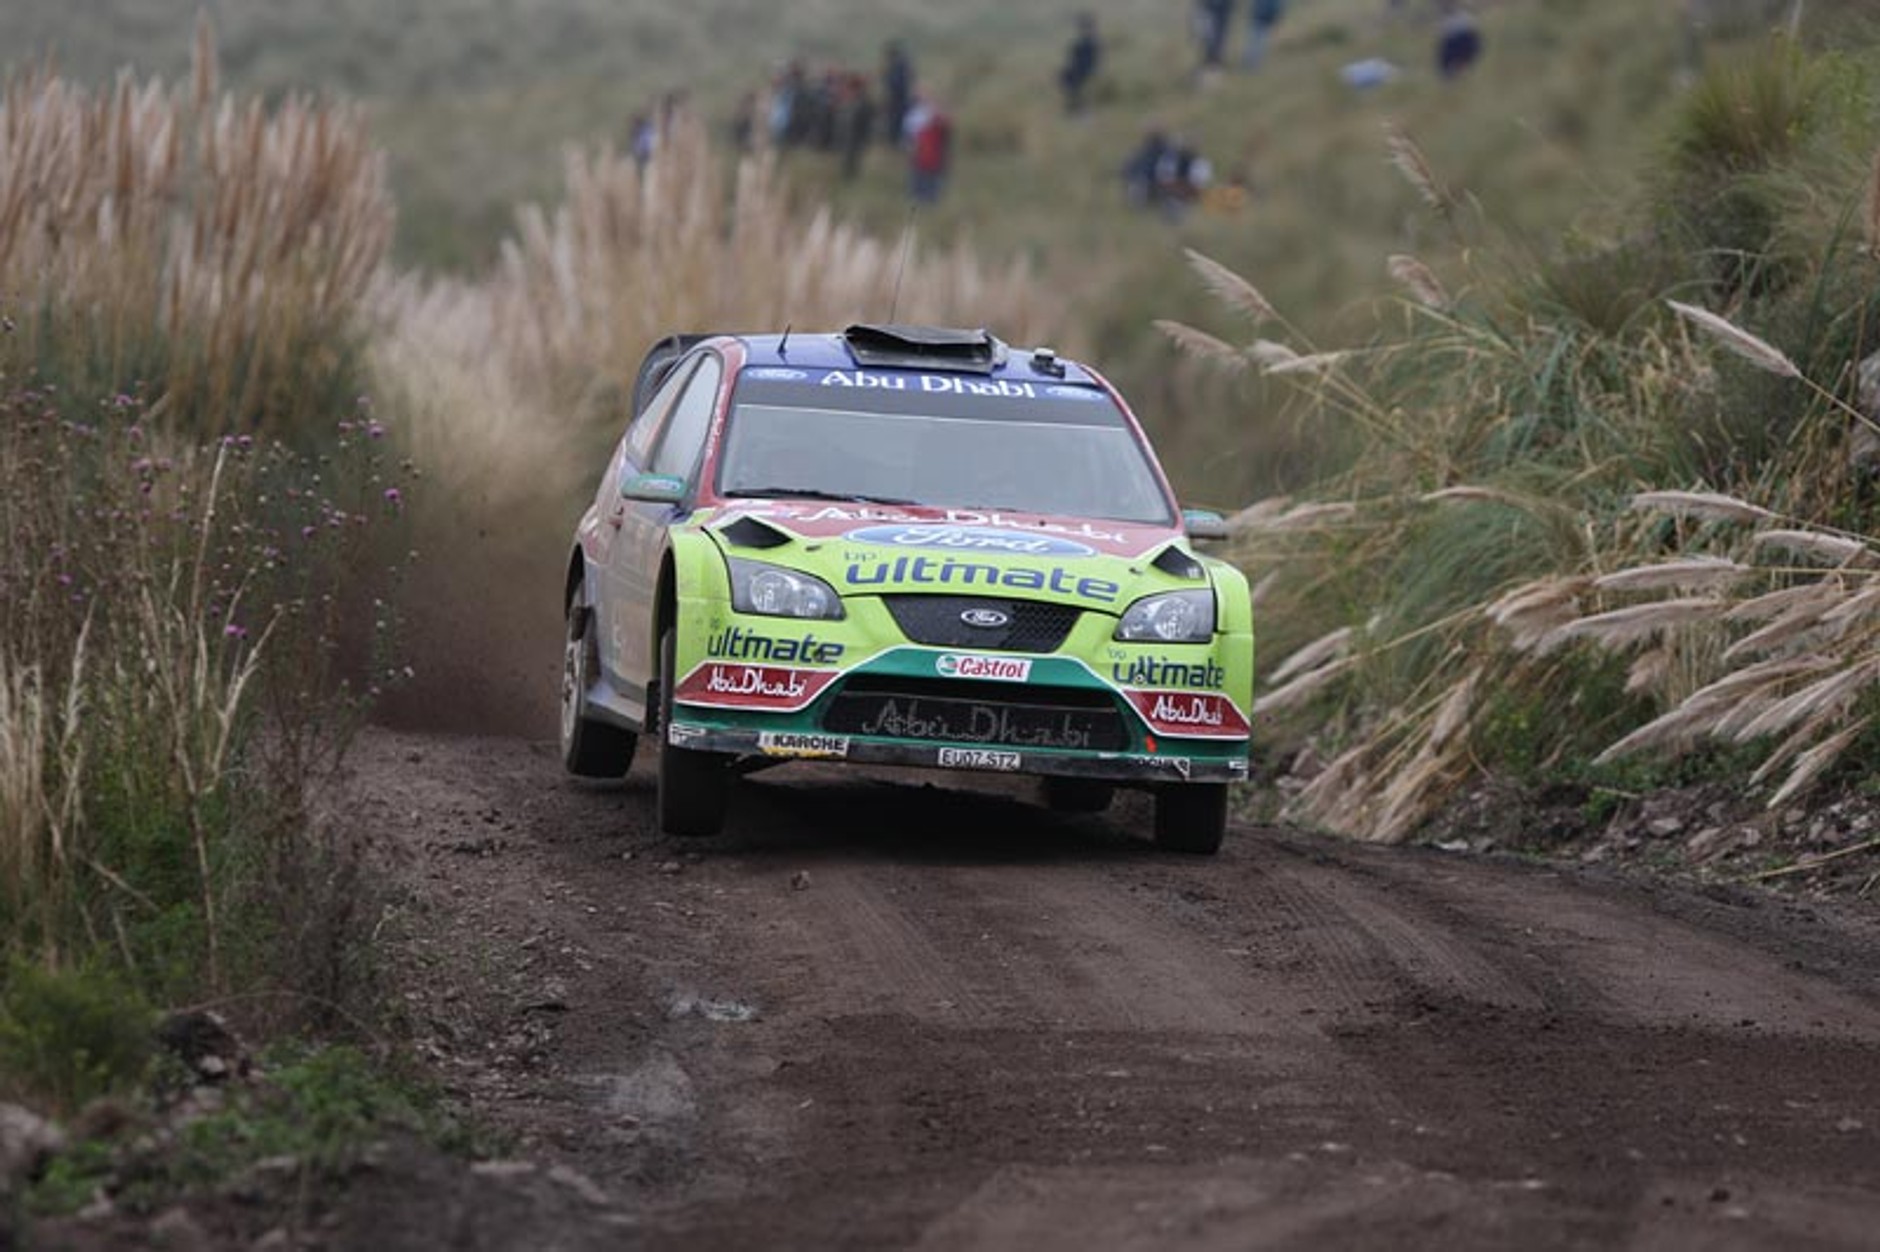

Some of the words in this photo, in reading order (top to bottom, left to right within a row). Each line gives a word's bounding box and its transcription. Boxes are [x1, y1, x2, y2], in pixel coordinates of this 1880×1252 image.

[820, 370, 904, 389] Abu
[920, 375, 1035, 398] Dhabi
[893, 527, 1051, 552] Ford
[846, 556, 1119, 602] ultimate
[706, 626, 844, 663] ultimate
[707, 666, 740, 692] Abu
[740, 668, 807, 696] Dhabi
[959, 657, 1024, 678] Castrol
[1113, 655, 1224, 688] ultimate
[862, 699, 952, 738] Abu
[964, 706, 1092, 746] Dhabi
[1151, 695, 1190, 722] Abu
